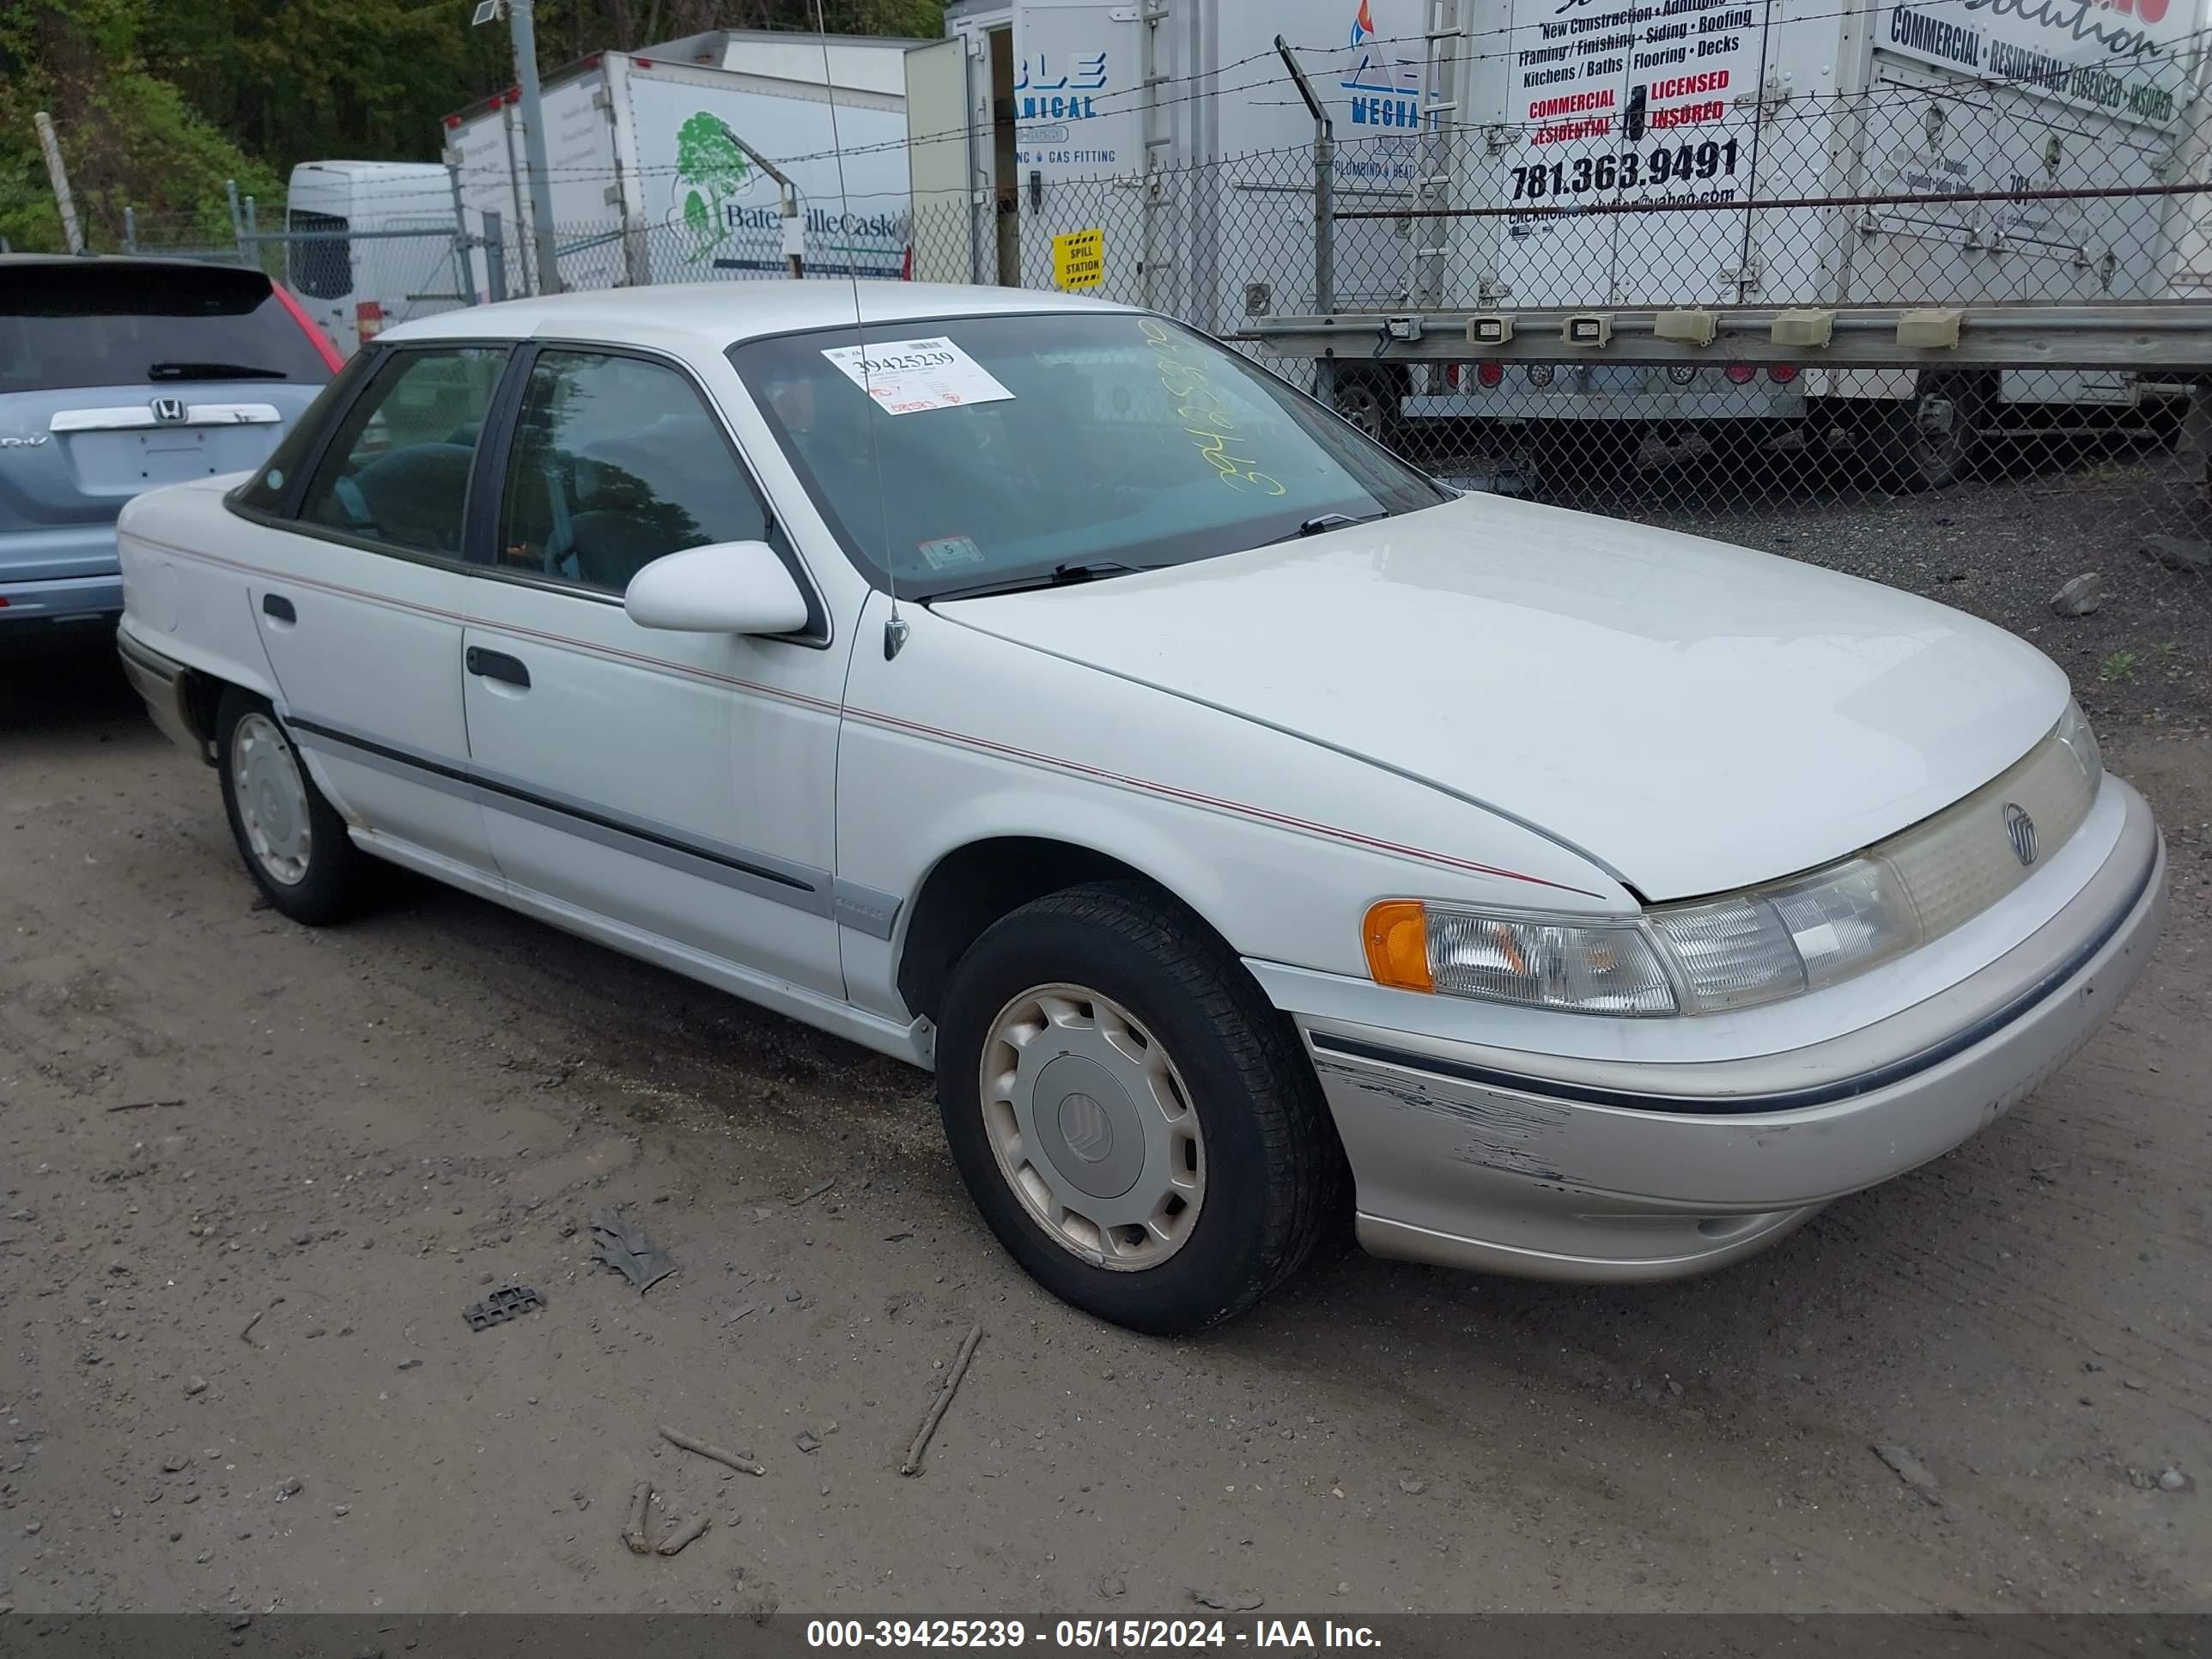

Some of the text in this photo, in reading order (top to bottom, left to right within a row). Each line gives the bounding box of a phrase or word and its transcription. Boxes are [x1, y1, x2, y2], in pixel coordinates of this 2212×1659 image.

[1519, 46, 1568, 67] Framing
[1577, 33, 1635, 56] Finishing
[1646, 23, 1687, 44] Siding
[1698, 9, 1752, 33] Roofing
[1542, 22, 1568, 40] New
[1571, 7, 1652, 35] Construction
[1965, 0, 2164, 58] olution
[1523, 66, 1576, 88] Kitchens
[1586, 58, 1623, 76] Baths
[1633, 46, 1686, 70] Flooring
[1697, 35, 1740, 58] Decks
[1891, 5, 1980, 67] COMMERCIAL
[1989, 40, 2063, 93] RESIDENTIAL
[2070, 69, 2123, 108] LICENSED
[1529, 70, 1729, 119] COMMERCIAL LICENSED
[1650, 101, 1724, 128] INSURED
[1048, 151, 1070, 163] GAS
[1074, 150, 1115, 162] FITTING
[1335, 160, 1381, 178] PLUMBING
[1511, 138, 1738, 201] 781.363.9491
[1066, 259, 1100, 274] STATION
[1071, 246, 1093, 259] SPILL
[852, 352, 955, 374] 39425239
